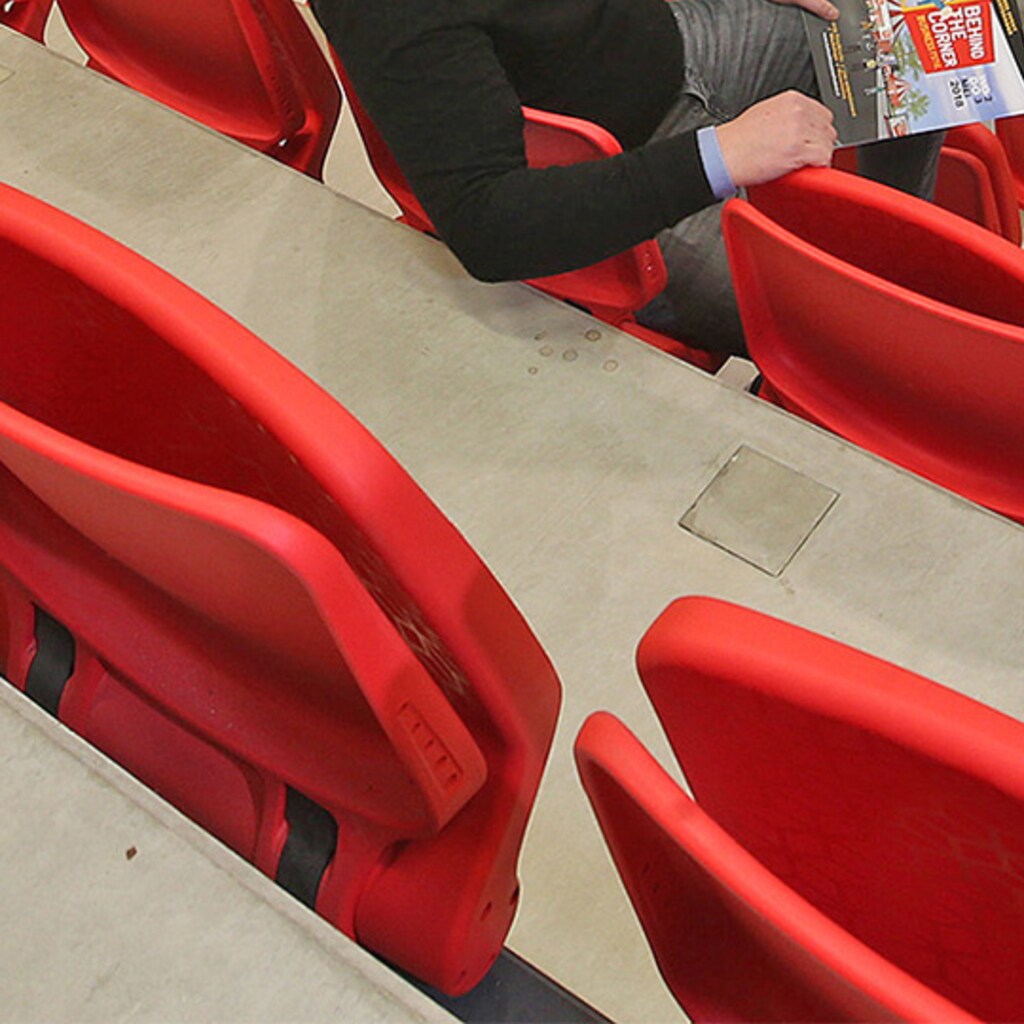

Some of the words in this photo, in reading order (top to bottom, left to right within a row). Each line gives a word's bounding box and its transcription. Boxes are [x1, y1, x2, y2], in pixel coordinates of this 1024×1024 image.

[927, 10, 958, 67] CORNER
[949, 6, 967, 41] THE
[964, 5, 985, 59] BEHIND
[950, 79, 965, 108] 2018
